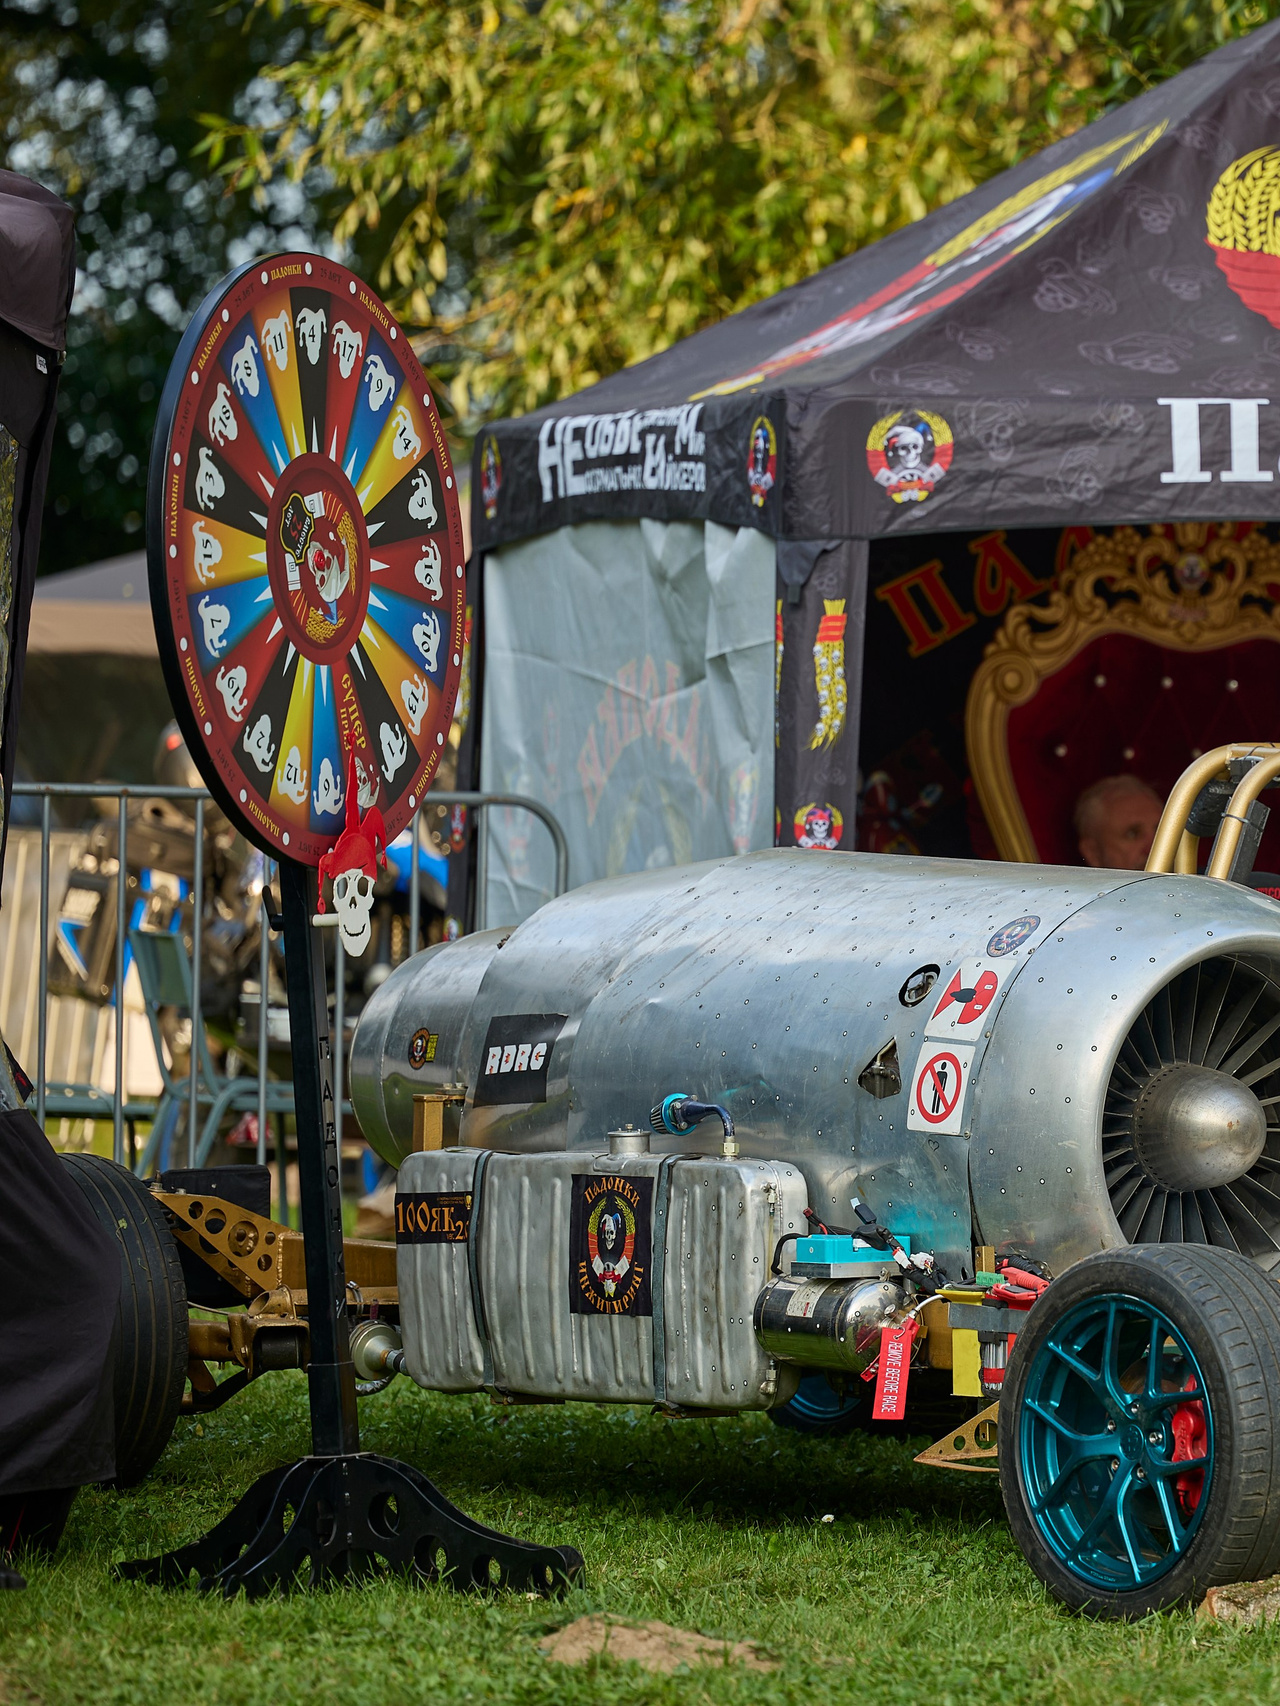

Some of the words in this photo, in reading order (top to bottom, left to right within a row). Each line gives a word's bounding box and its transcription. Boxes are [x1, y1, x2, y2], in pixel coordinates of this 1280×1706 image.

[271, 265, 301, 280] ПАДОНКИ
[360, 291, 390, 329] ПАДОНКИ
[273, 332, 284, 352] 11
[308, 324, 315, 342] 4
[198, 322, 222, 370] ПАДОНКИ
[342, 340, 354, 362] 17
[244, 360, 252, 377] 8
[375, 379, 382, 392] 9
[219, 405, 230, 430] 18
[399, 426, 412, 450] 14
[429, 412, 448, 470] ПАДОНКИ
[205, 472, 215, 486] 3
[170, 474, 180, 537] ПАДОНКИ
[417, 496, 428, 508] 5
[290, 515, 302, 540] 25
[202, 538, 212, 560] 15
[424, 563, 434, 584] 16
[210, 618, 222, 628] 7
[455, 589, 463, 650] ПАДОНКИ
[421, 631, 432, 654] 10
[185, 656, 206, 716] ПАДОНКИ
[228, 676, 240, 698] 19
[341, 674, 367, 749] СУПЕР
[408, 691, 419, 714] 13
[256, 732, 264, 748] 2
[388, 741, 395, 758] 1
[286, 763, 298, 784] 12
[414, 750, 438, 797] ПАДОНКИ
[249, 800, 280, 837] ПАДОНКИ
[484, 1043, 547, 1075] RDRC
[319, 1036, 346, 1319] ПАДОНКИ
[584, 1176, 640, 1208] ПАДОНКИ
[887, 1341, 904, 1367] REMOVE
[884, 1368, 900, 1394] BEFORE
[881, 1394, 898, 1413] RACE
